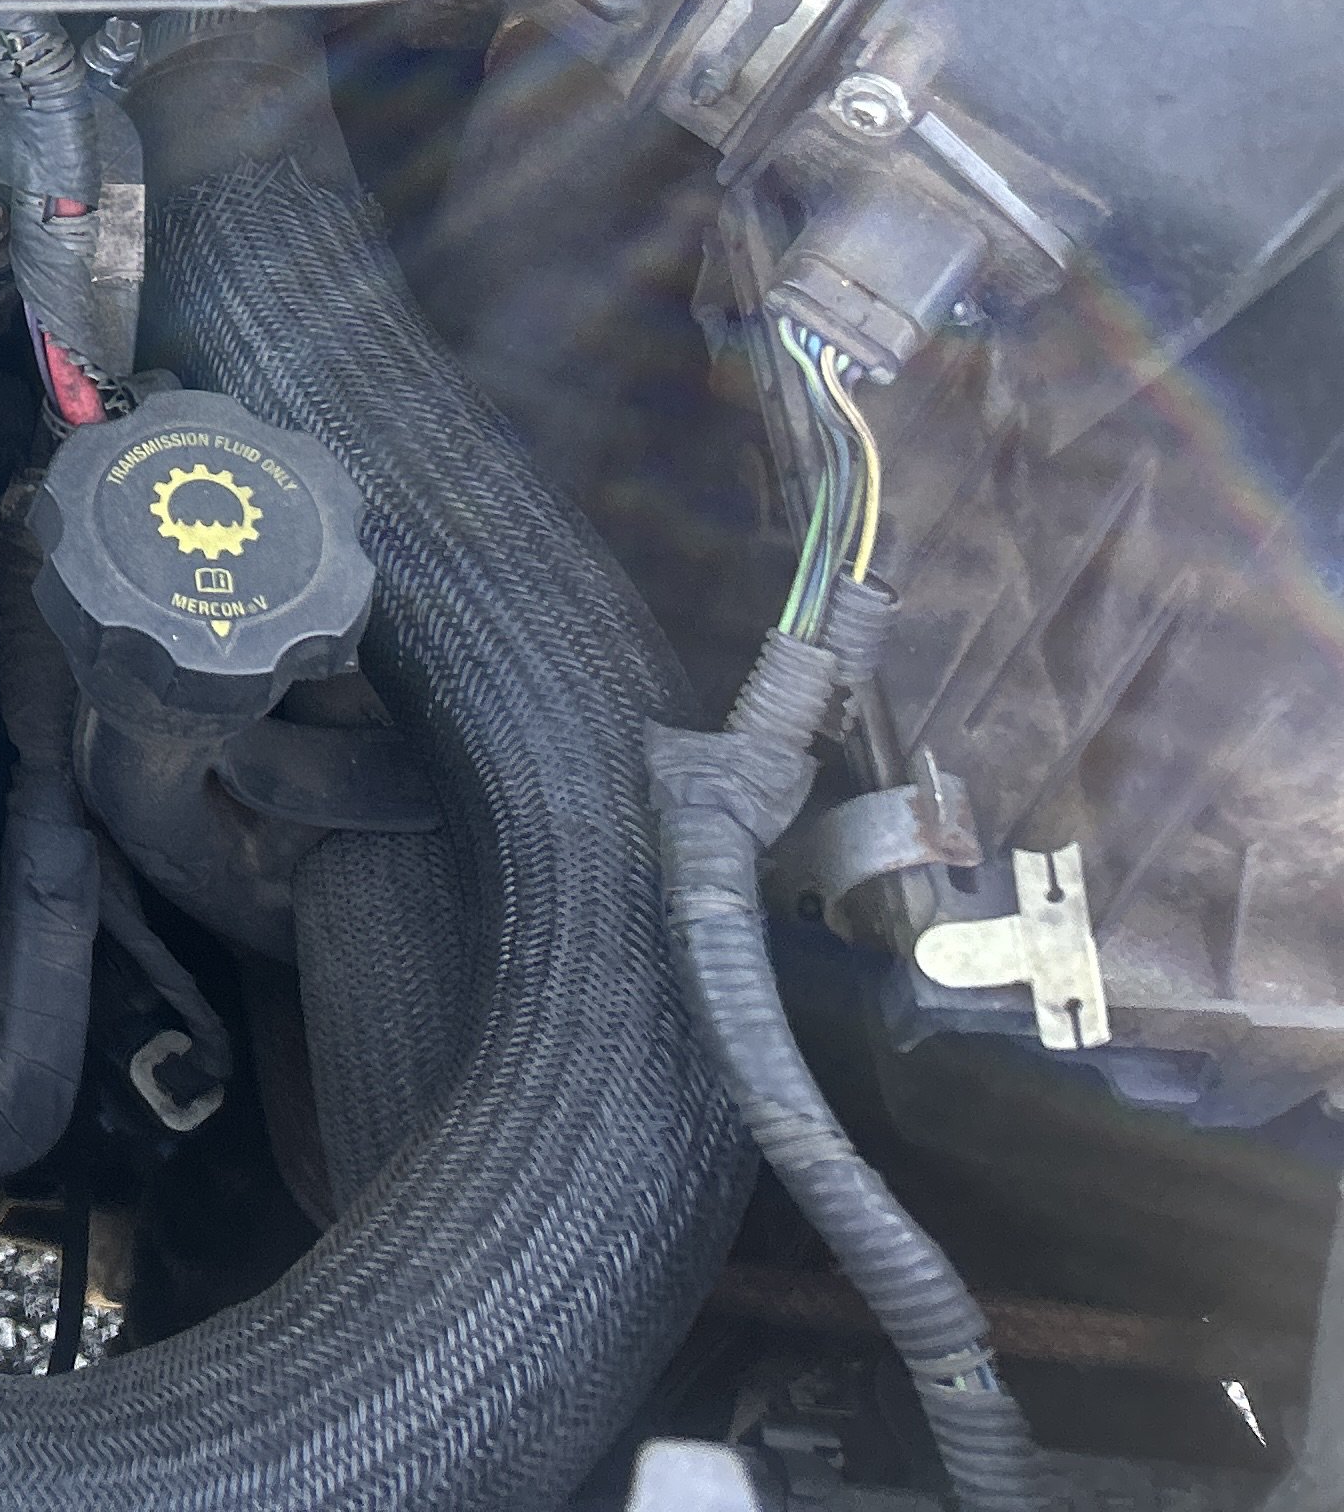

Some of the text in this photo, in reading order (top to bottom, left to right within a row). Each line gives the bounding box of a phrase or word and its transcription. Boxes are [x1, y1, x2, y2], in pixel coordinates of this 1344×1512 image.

[106, 432, 298, 492] TRANSMISSION FLUID ONLY
